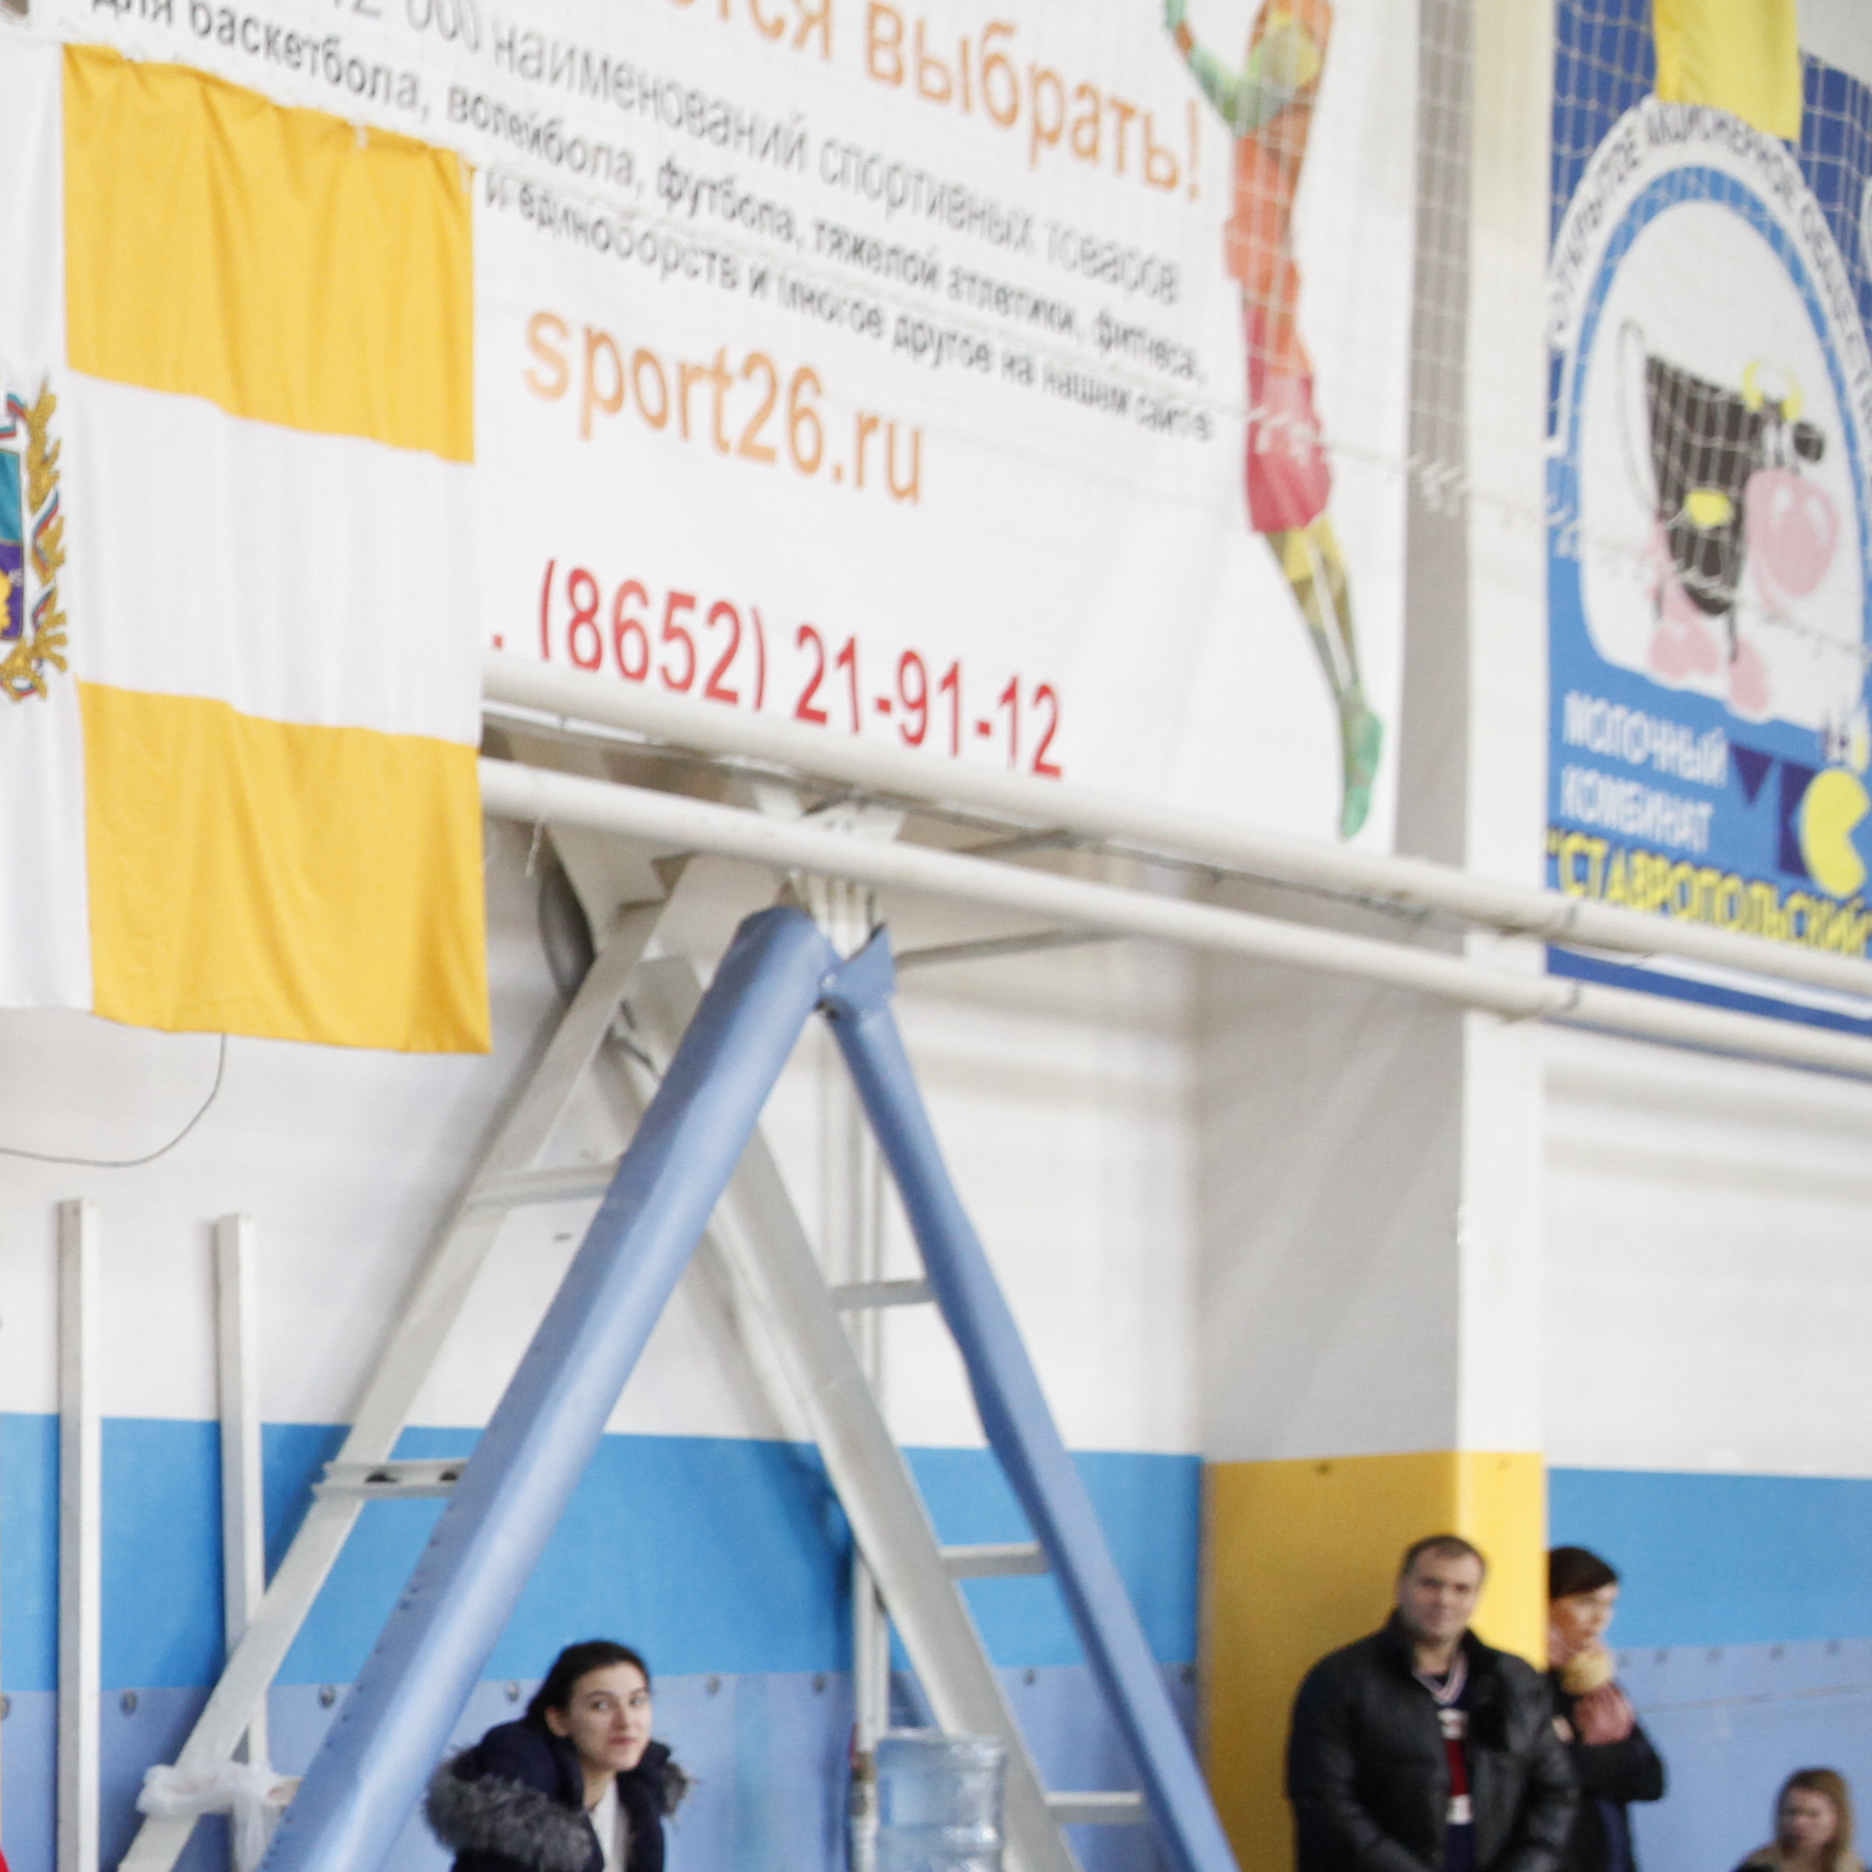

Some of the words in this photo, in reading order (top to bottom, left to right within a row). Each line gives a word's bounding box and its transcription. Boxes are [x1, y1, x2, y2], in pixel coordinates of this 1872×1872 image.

[188, 0, 431, 122] баскетбола,
[445, 83, 644, 200] волейбола,
[657, 154, 805, 251] футбола,
[946, 262, 1085, 346] атлетики,
[1090, 304, 1209, 388] фитнеса,
[492, 18, 808, 173] наименований
[818, 137, 1035, 256] спортивных
[1044, 217, 1181, 306] товаров
[863, 0, 1200, 200] выбрать!
[484, 166, 510, 213] и
[517, 180, 740, 291] единоборств
[748, 263, 771, 300] и
[776, 270, 886, 341] многое
[892, 314, 995, 374] другое
[1000, 348, 1037, 388] на
[521, 310, 925, 505] sport26.ru
[536, 557, 767, 713] (8652)
[794, 622, 1064, 780] 21-91-12
